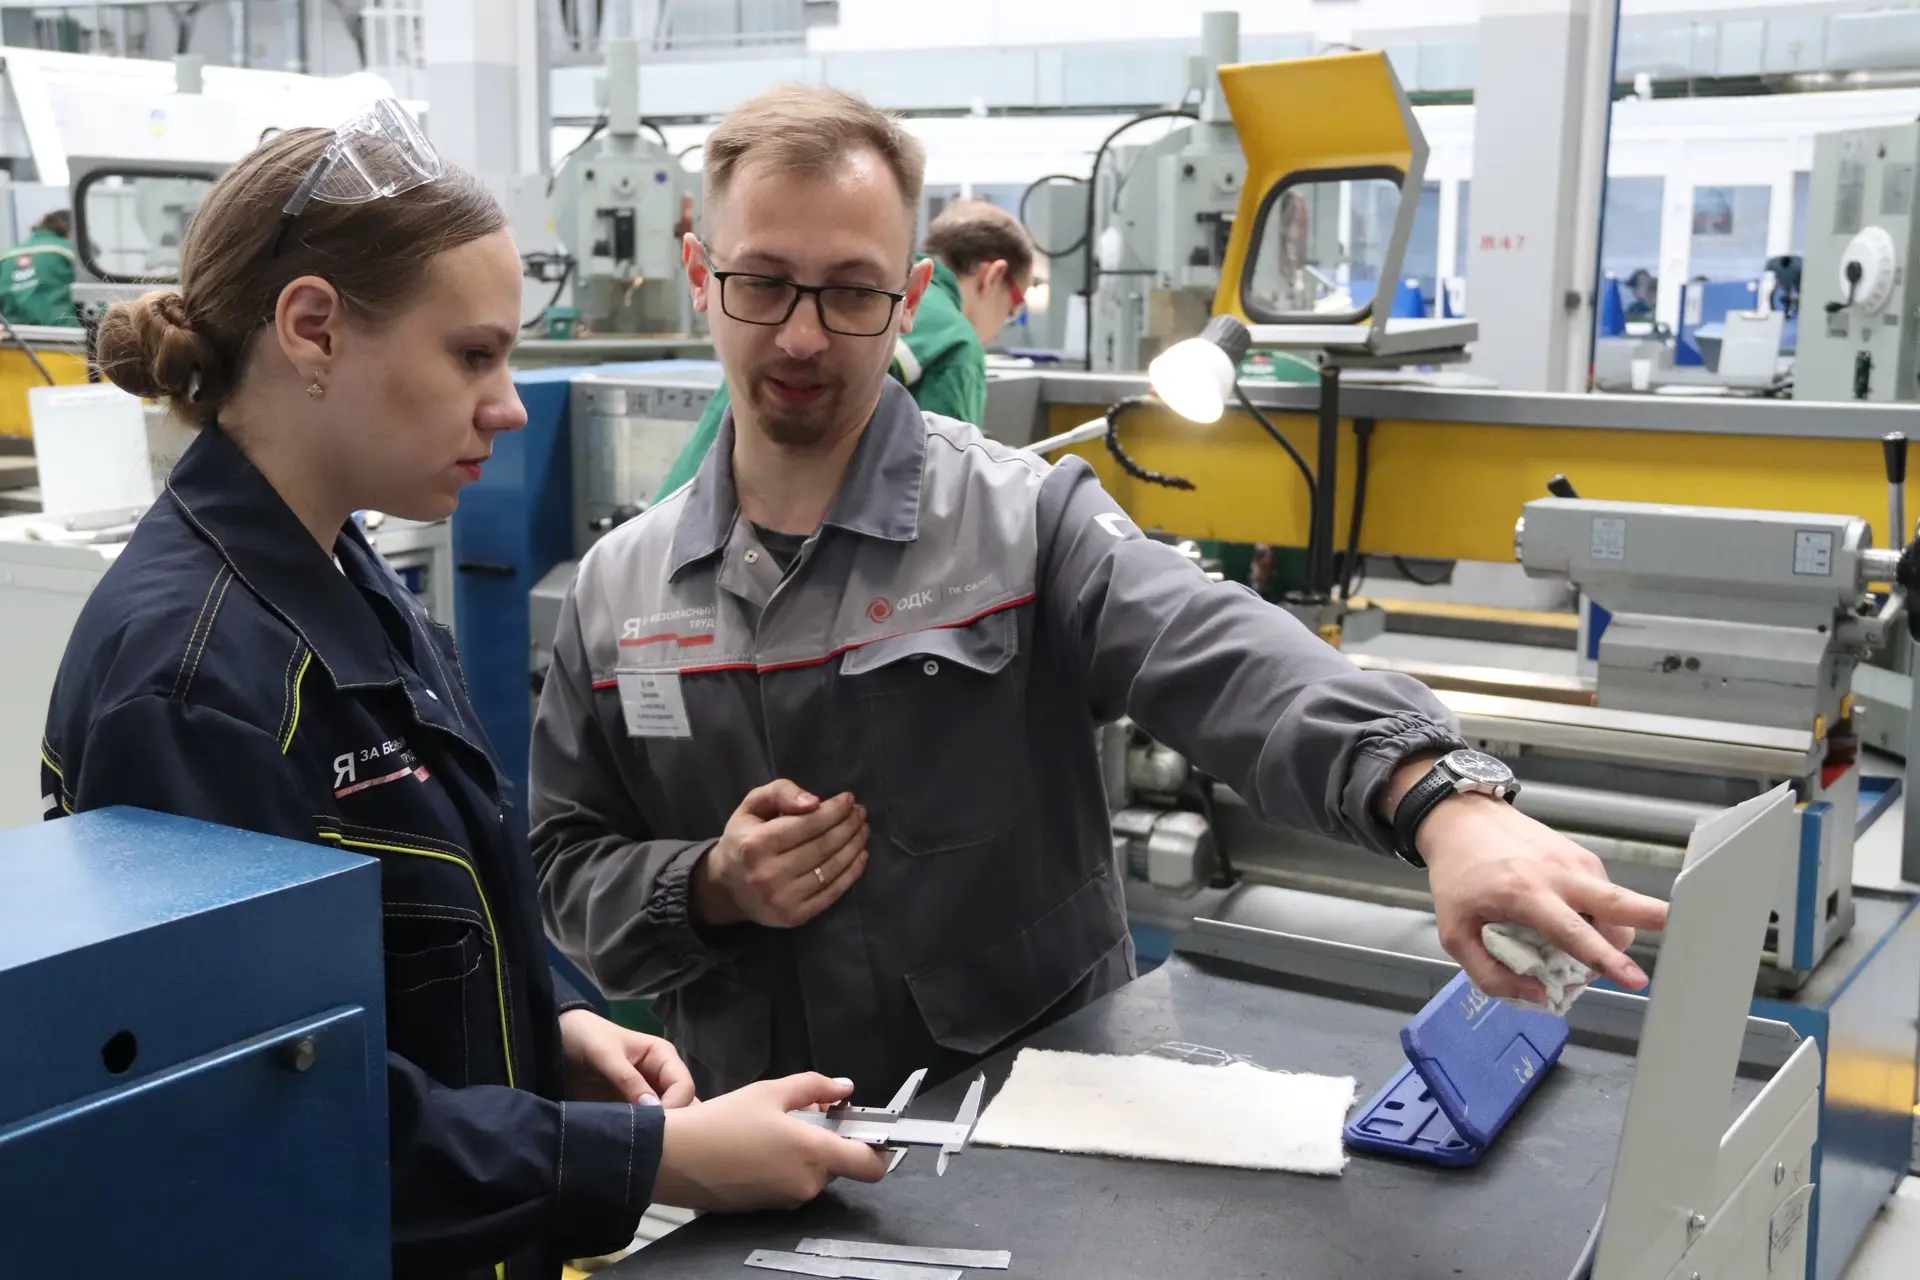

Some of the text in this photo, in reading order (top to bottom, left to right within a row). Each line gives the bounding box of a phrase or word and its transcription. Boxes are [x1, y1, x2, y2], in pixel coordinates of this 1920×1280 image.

[621, 617, 641, 639] Я
[333, 752, 356, 789] Я
[360, 746, 380, 762] ЗА
